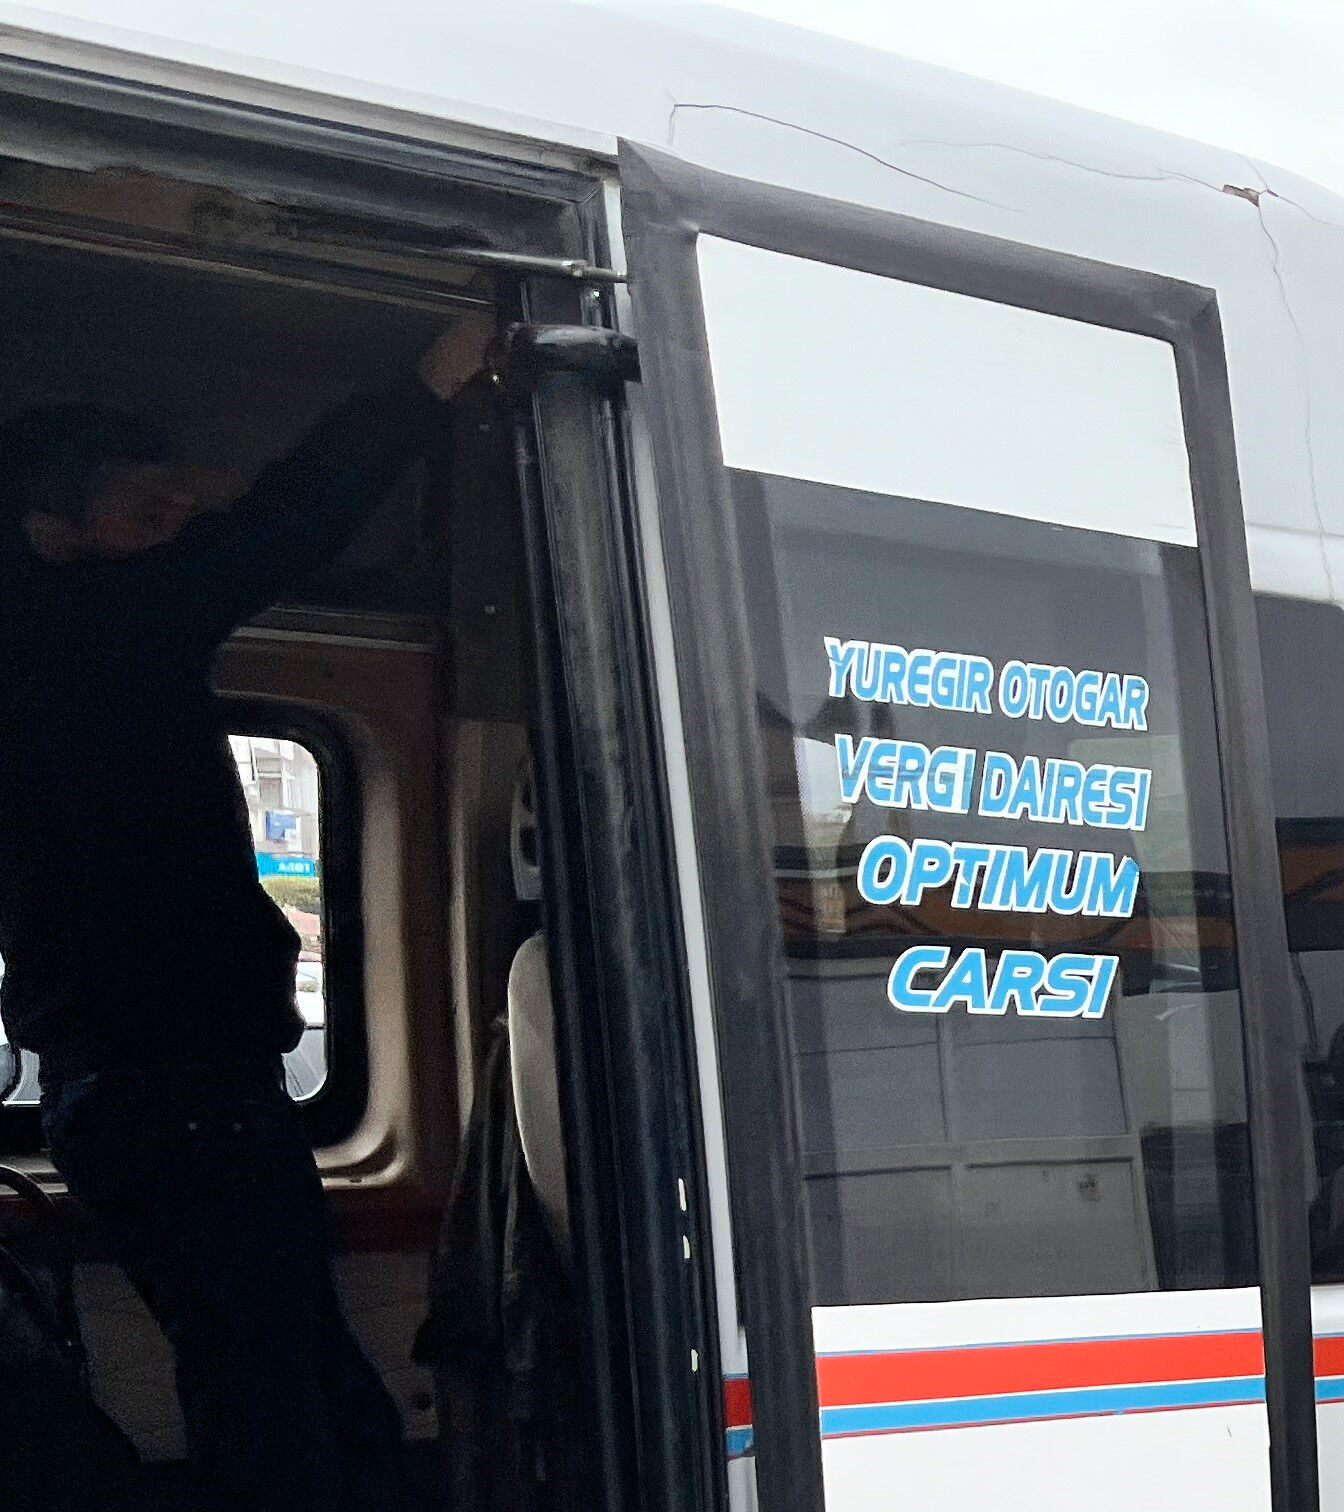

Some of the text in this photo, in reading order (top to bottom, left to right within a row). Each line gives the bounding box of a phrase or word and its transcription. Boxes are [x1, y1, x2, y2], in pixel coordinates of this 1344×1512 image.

[824, 636, 1149, 731] YUREGIR OTOGAR
[835, 734, 1152, 831] VERGI DAIRESI
[857, 835, 1140, 917] OPTIMUM
[887, 945, 1120, 1019] CARSI
